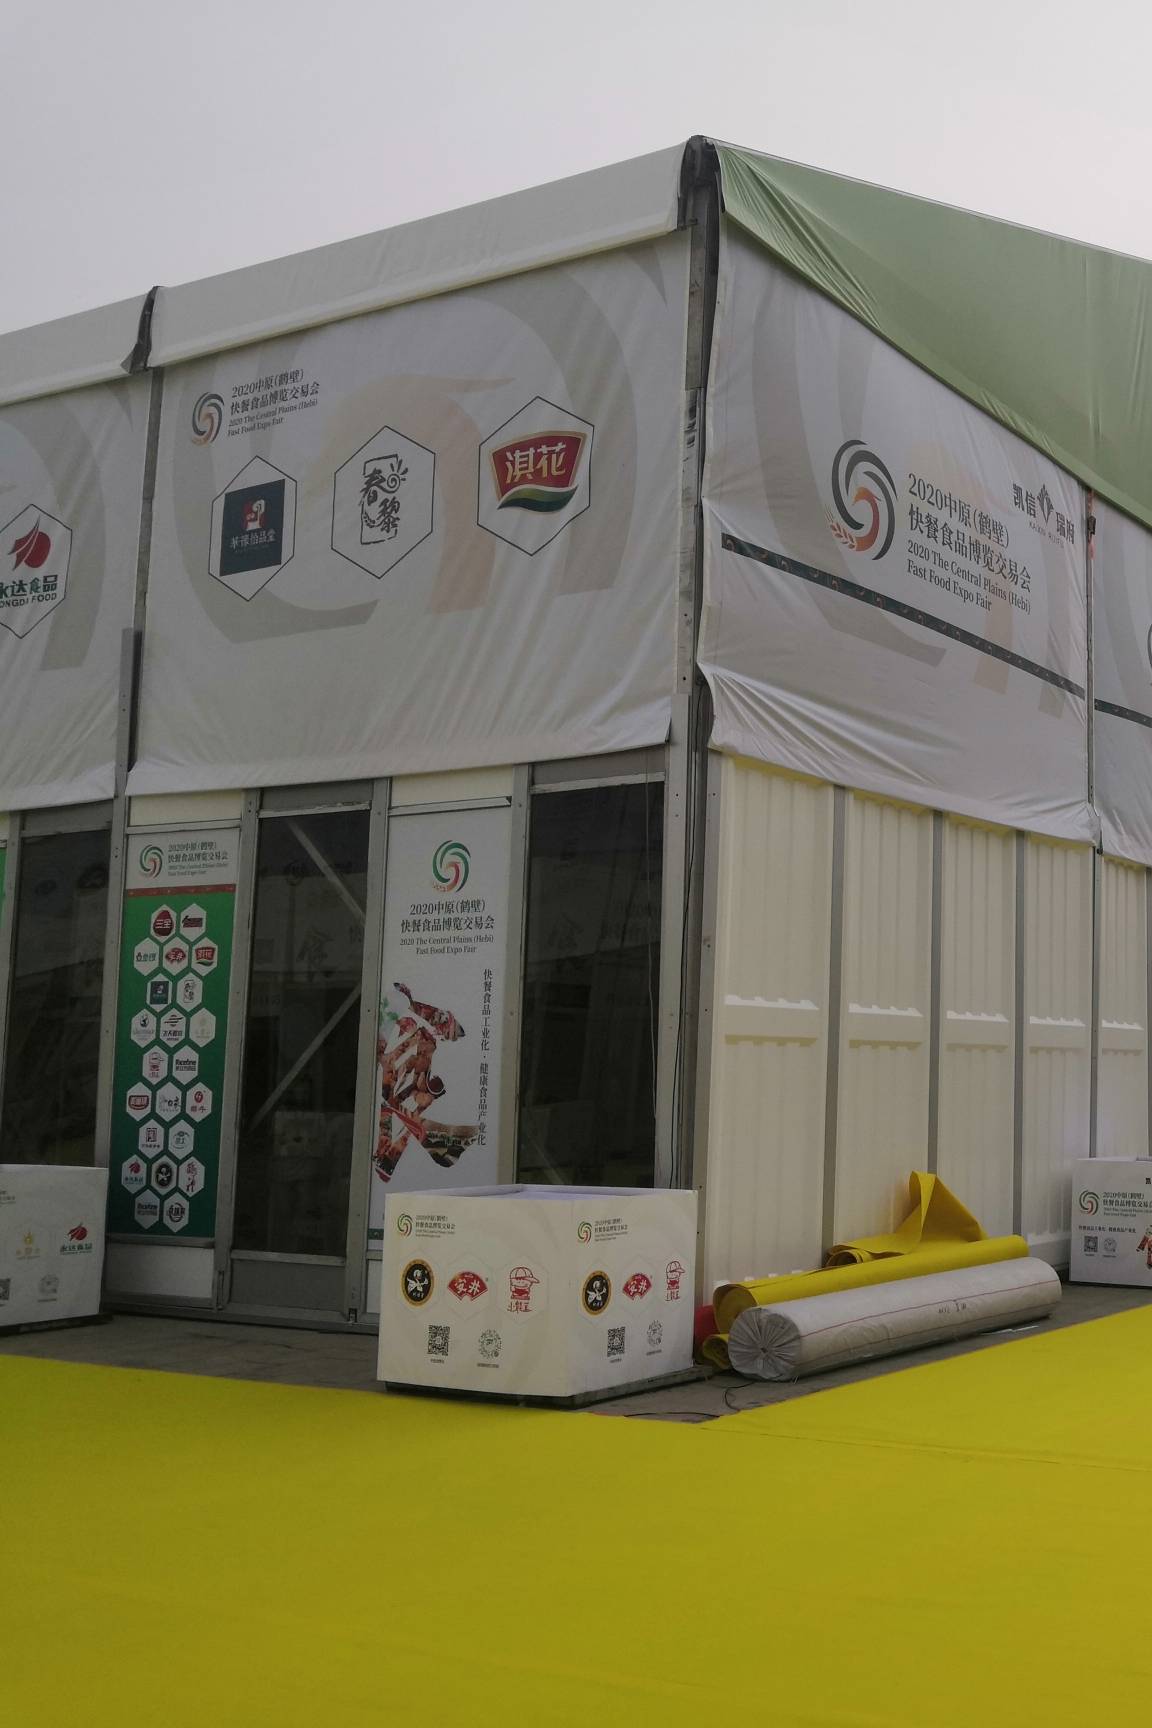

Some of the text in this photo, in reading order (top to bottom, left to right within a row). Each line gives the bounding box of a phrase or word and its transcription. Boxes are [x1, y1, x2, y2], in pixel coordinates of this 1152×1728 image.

[505, 442, 567, 484] 淇花
[908, 473, 1010, 549] 2020中原(鹤壁)
[909, 503, 1031, 593] 快餐食品博览交易会
[907, 540, 1031, 615] 2020 The Central Plains (Hebi)
[907, 559, 993, 612] Fast Food Expo Fair
[31, 592, 57, 604] FOOD
[401, 915, 495, 933] 快餐食品博览交易会
[416, 937, 428, 945] The
[416, 947, 428, 955] Fast
[430, 946, 445, 954] Food
[454, 1278, 481, 1295] 安井
